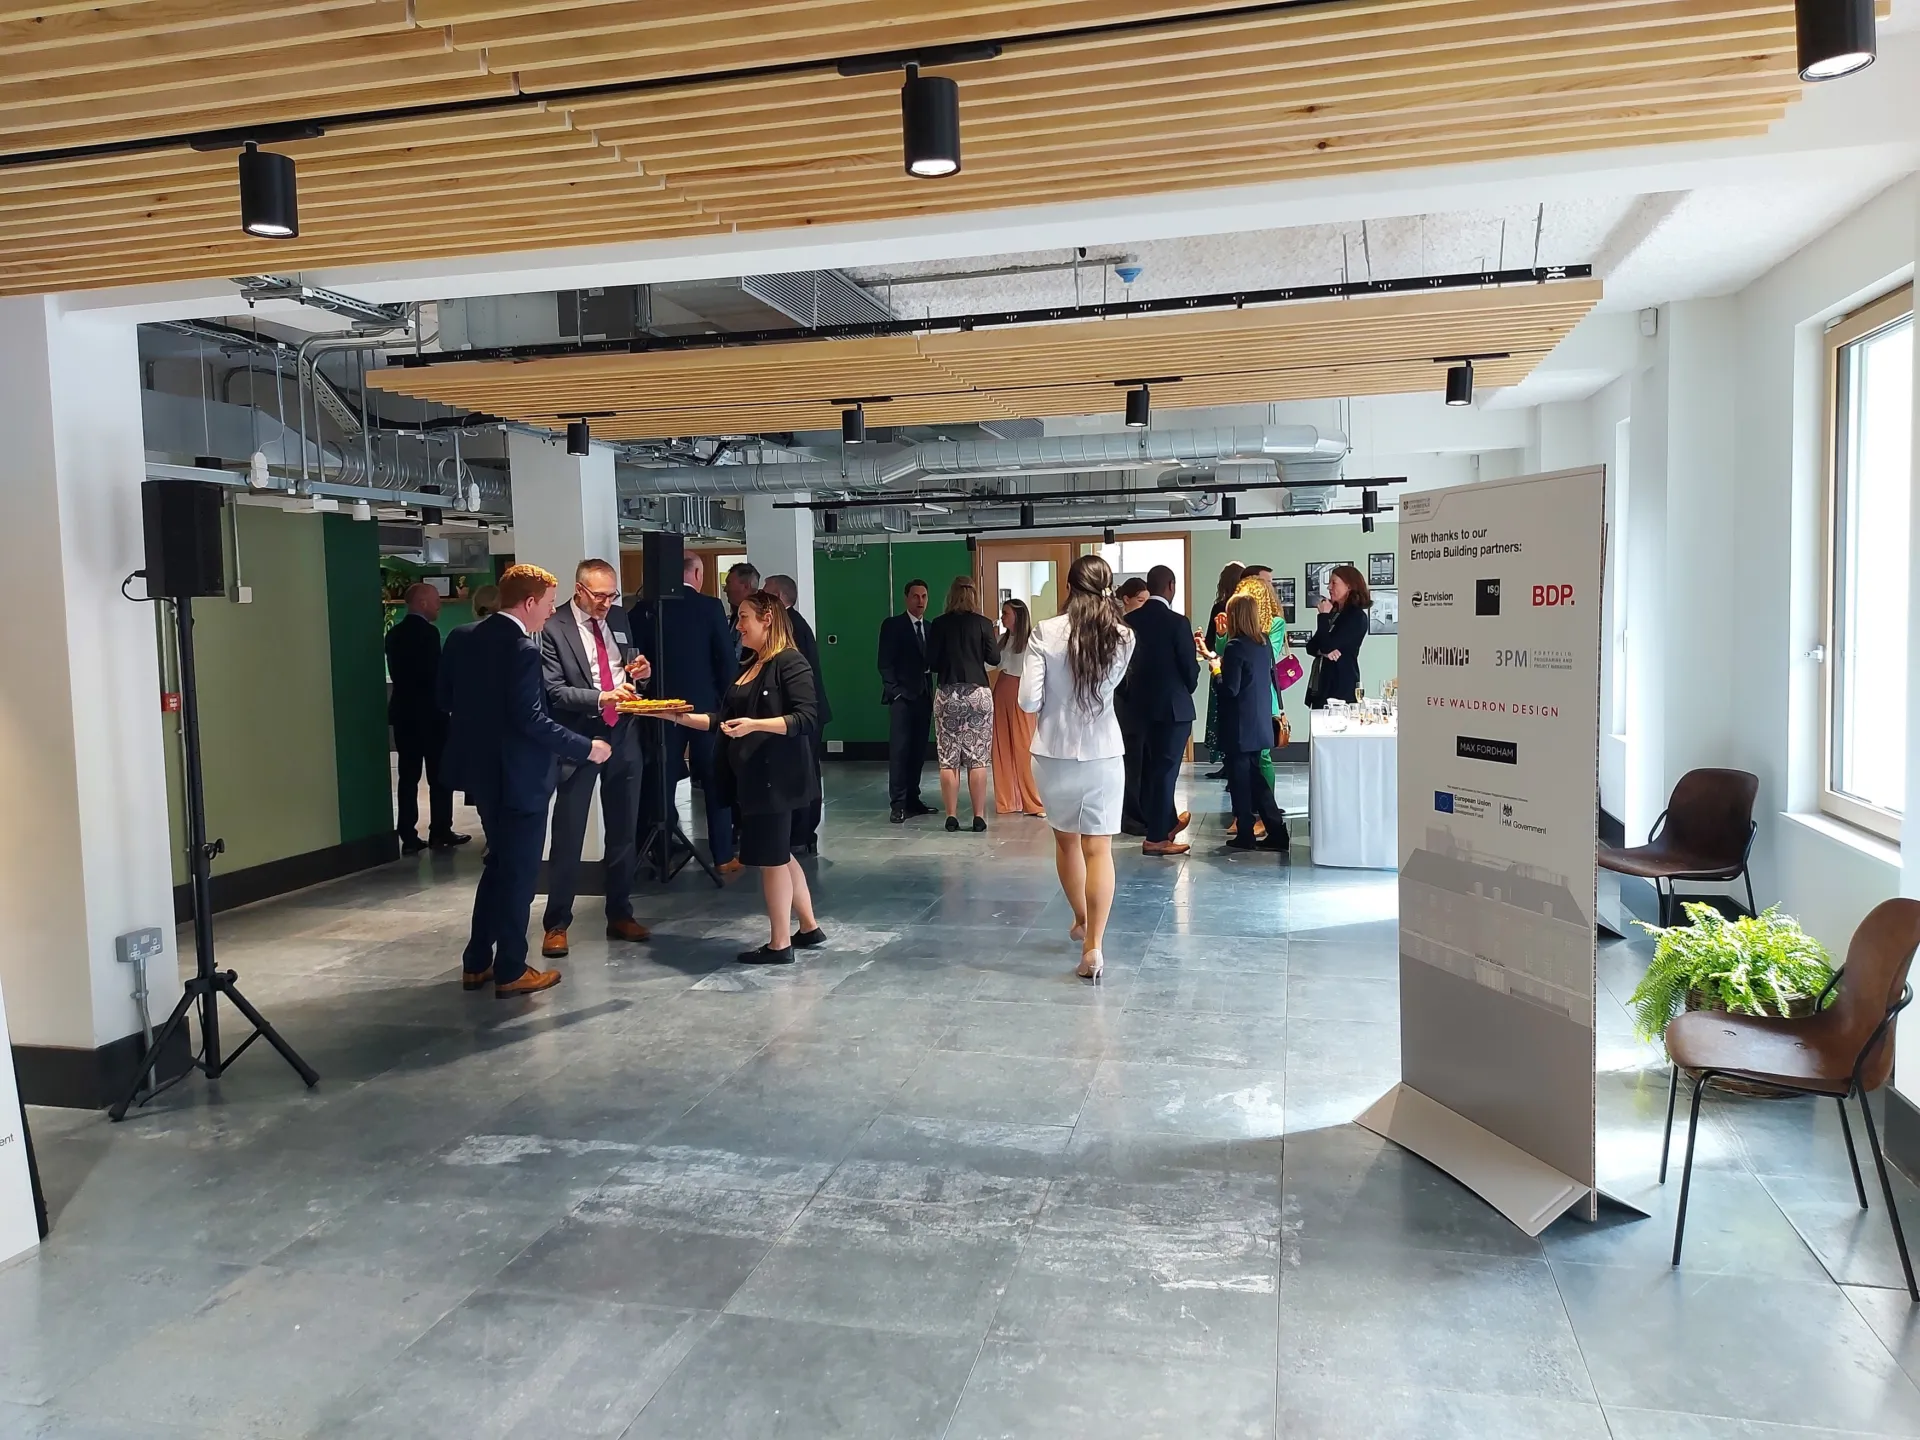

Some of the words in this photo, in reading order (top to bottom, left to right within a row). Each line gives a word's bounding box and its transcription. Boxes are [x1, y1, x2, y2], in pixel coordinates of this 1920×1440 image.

[1410, 530, 1429, 545] With
[1431, 529, 1459, 543] thanks
[1461, 529, 1470, 540] to
[1472, 528, 1488, 539] our
[1410, 548, 1441, 561] Entopia
[1443, 545, 1478, 559] Building
[1479, 542, 1523, 557] partners:
[1423, 591, 1454, 602] Envision
[1532, 584, 1576, 607] BDP.
[1421, 646, 1470, 667] ARCHITYPE
[1495, 650, 1528, 668] 3PM
[1426, 696, 1445, 707] EVE
[1450, 698, 1506, 713] WALDRON
[1512, 703, 1559, 718] DESIGN
[1459, 742, 1476, 753] MAX
[1477, 744, 1514, 758] FORDHAM
[1454, 794, 1476, 805] European
[1477, 798, 1492, 807] Union
[1502, 818, 1512, 827] HM
[1512, 820, 1547, 835] Government
